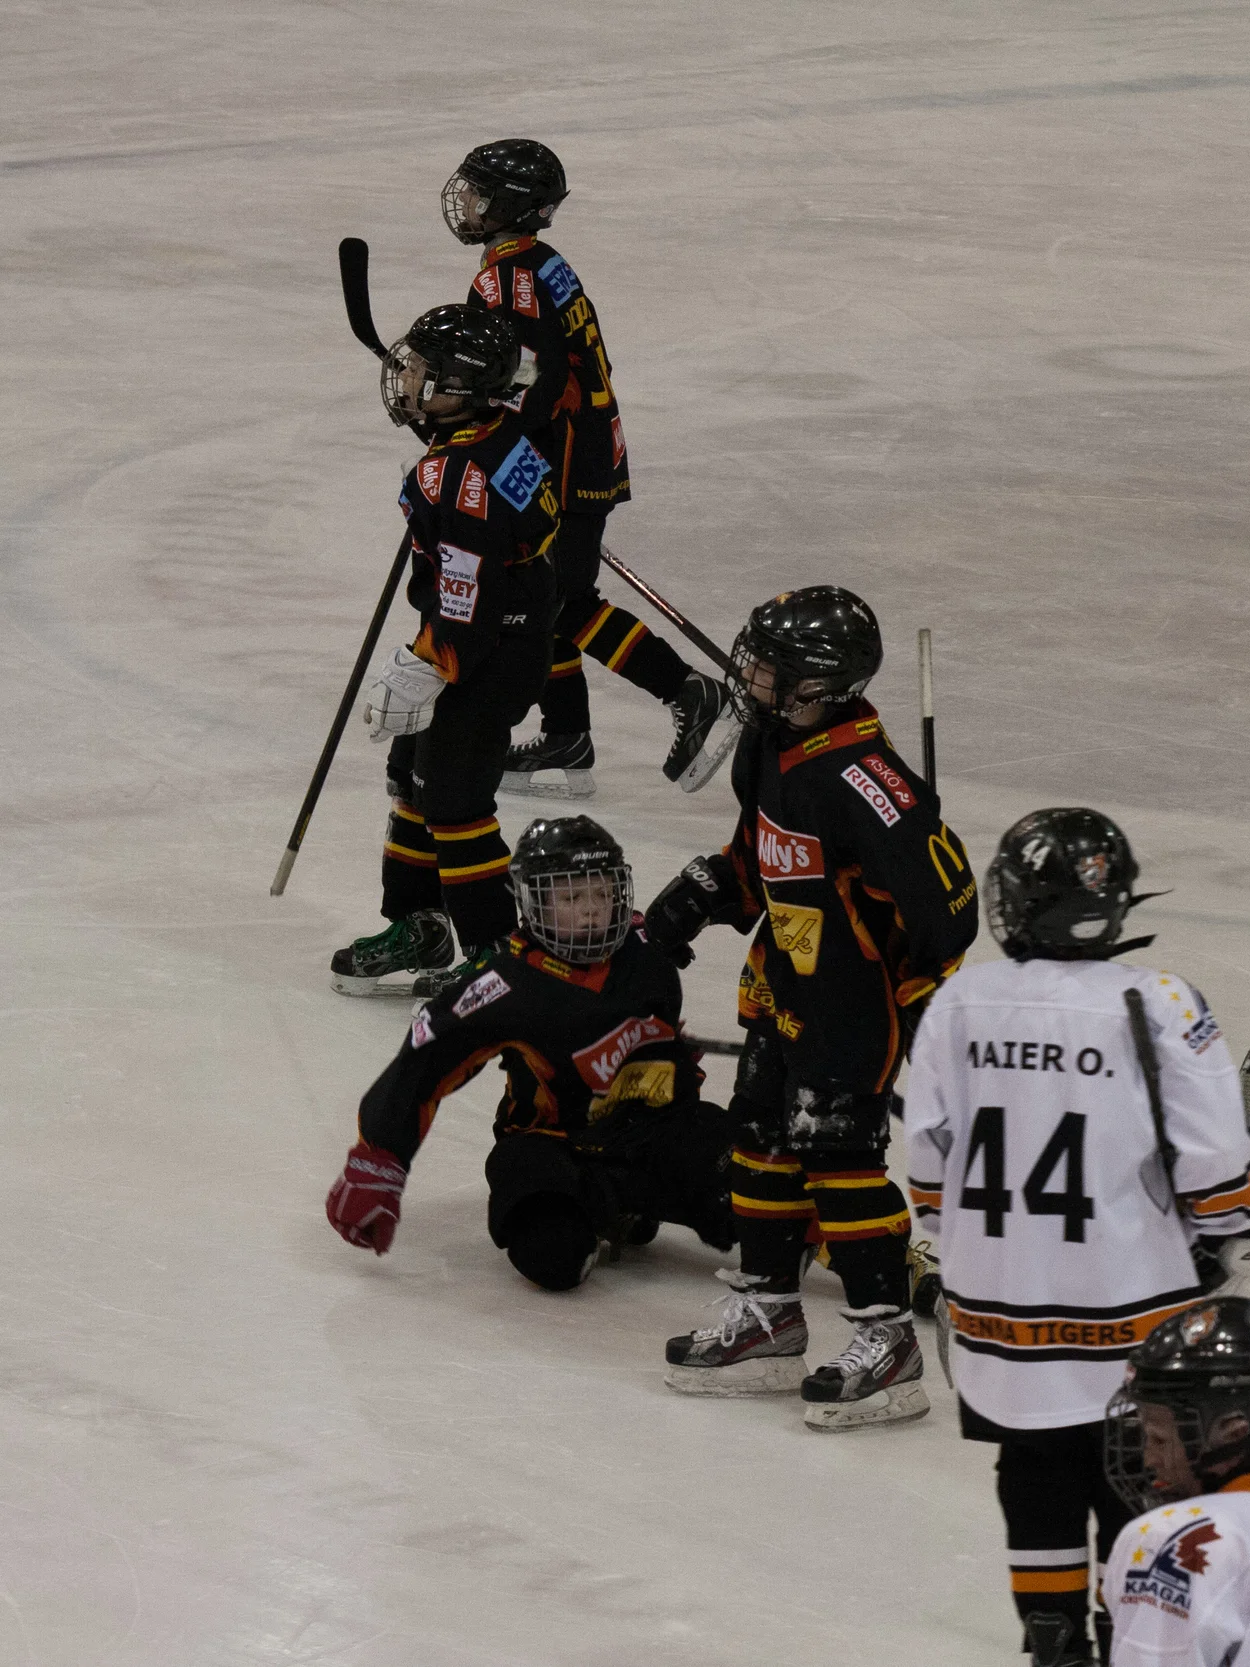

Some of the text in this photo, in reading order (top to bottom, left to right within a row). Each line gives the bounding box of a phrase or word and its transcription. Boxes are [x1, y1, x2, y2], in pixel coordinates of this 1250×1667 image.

[478, 270, 498, 303] Kelly's
[517, 272, 532, 309] Kelly's
[454, 352, 487, 368] BAUER
[423, 459, 440, 497] Kelly's
[465, 469, 482, 509] Kelly's
[441, 576, 476, 598] KEY
[804, 655, 839, 667] BAUER
[866, 757, 903, 788] ASKÖ
[846, 768, 896, 823] RICOH
[1021, 838, 1052, 871] 44
[1076, 1047, 1114, 1078] O.
[959, 1106, 1095, 1244] 44
[1028, 1321, 1136, 1345] TIGERS
